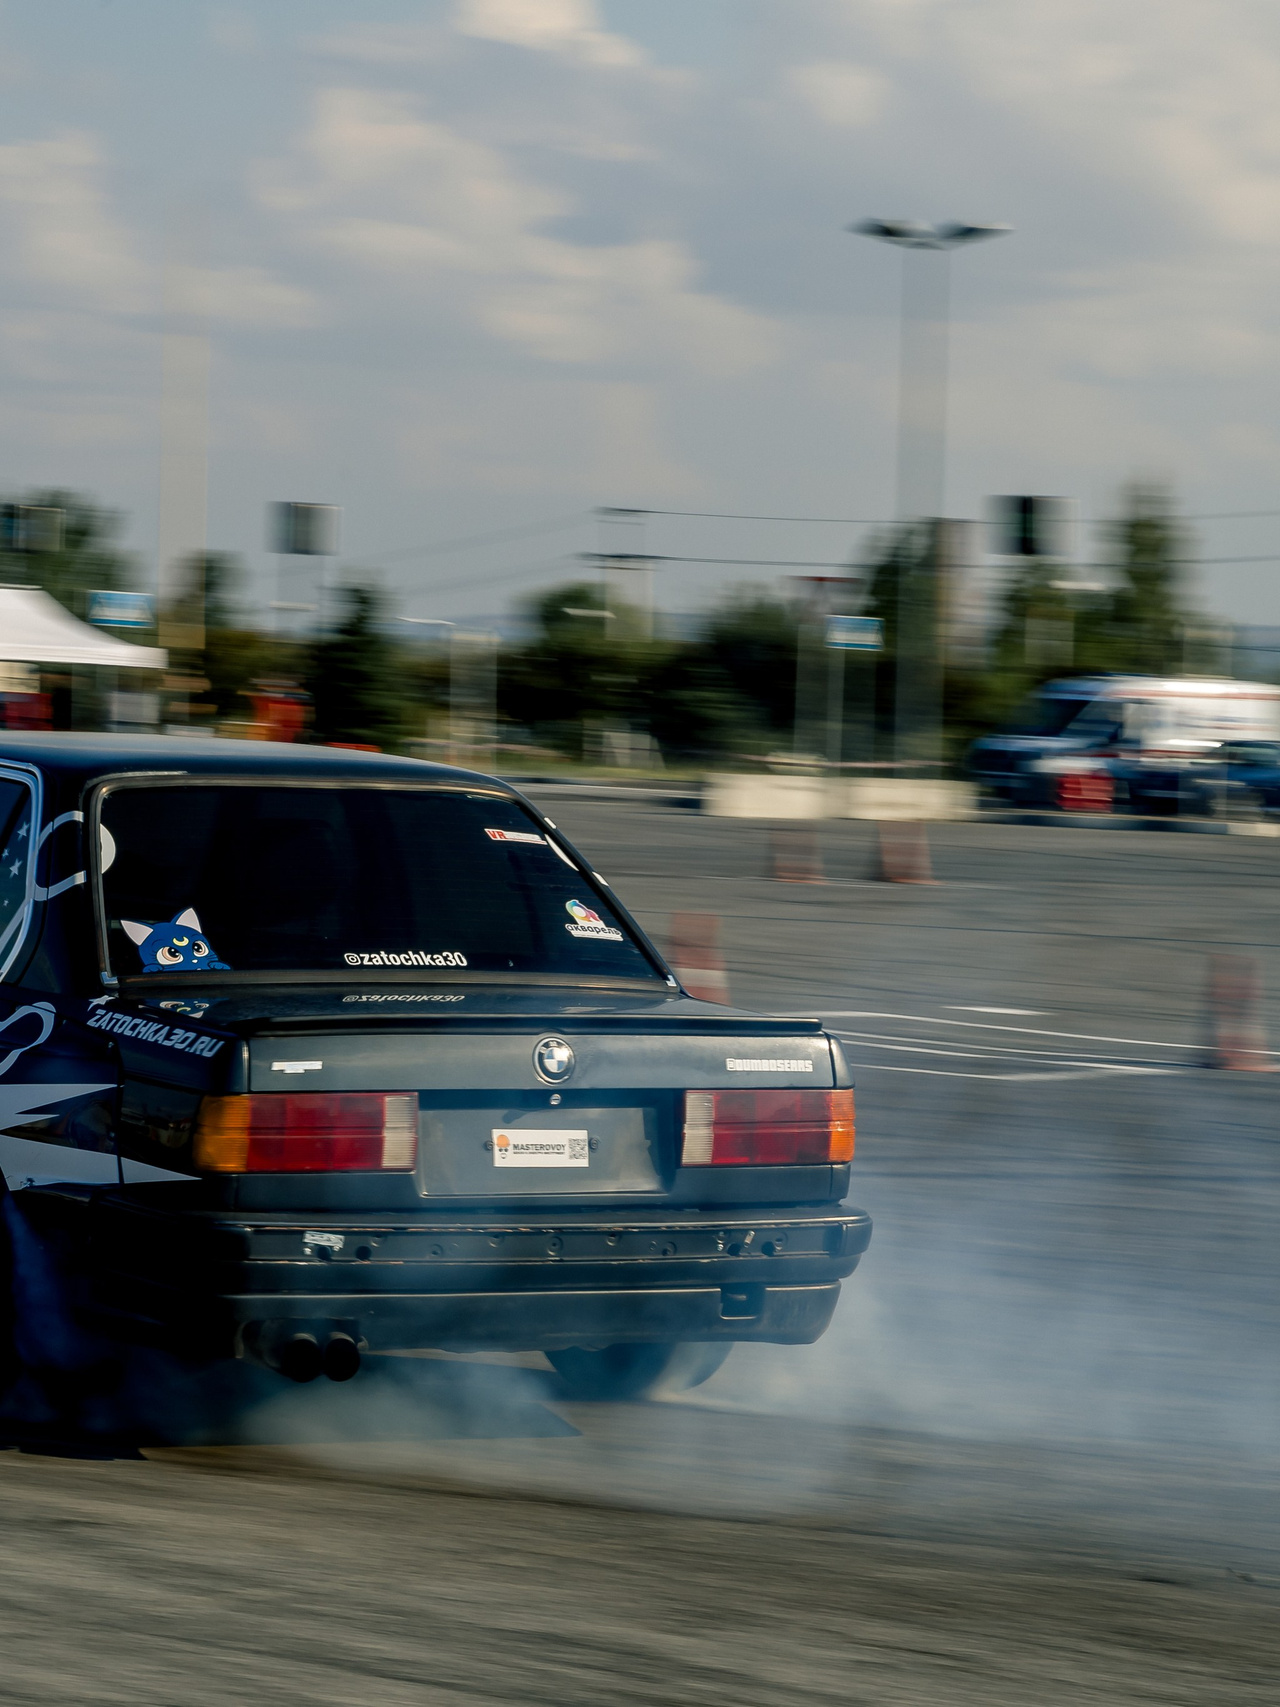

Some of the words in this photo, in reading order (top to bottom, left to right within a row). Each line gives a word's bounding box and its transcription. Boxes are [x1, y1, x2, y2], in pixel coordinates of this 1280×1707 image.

[566, 924, 621, 936] акварель
[86, 1008, 225, 1058] ZATOCHKA30.RU
[512, 1143, 567, 1152] MASTEROVOY
